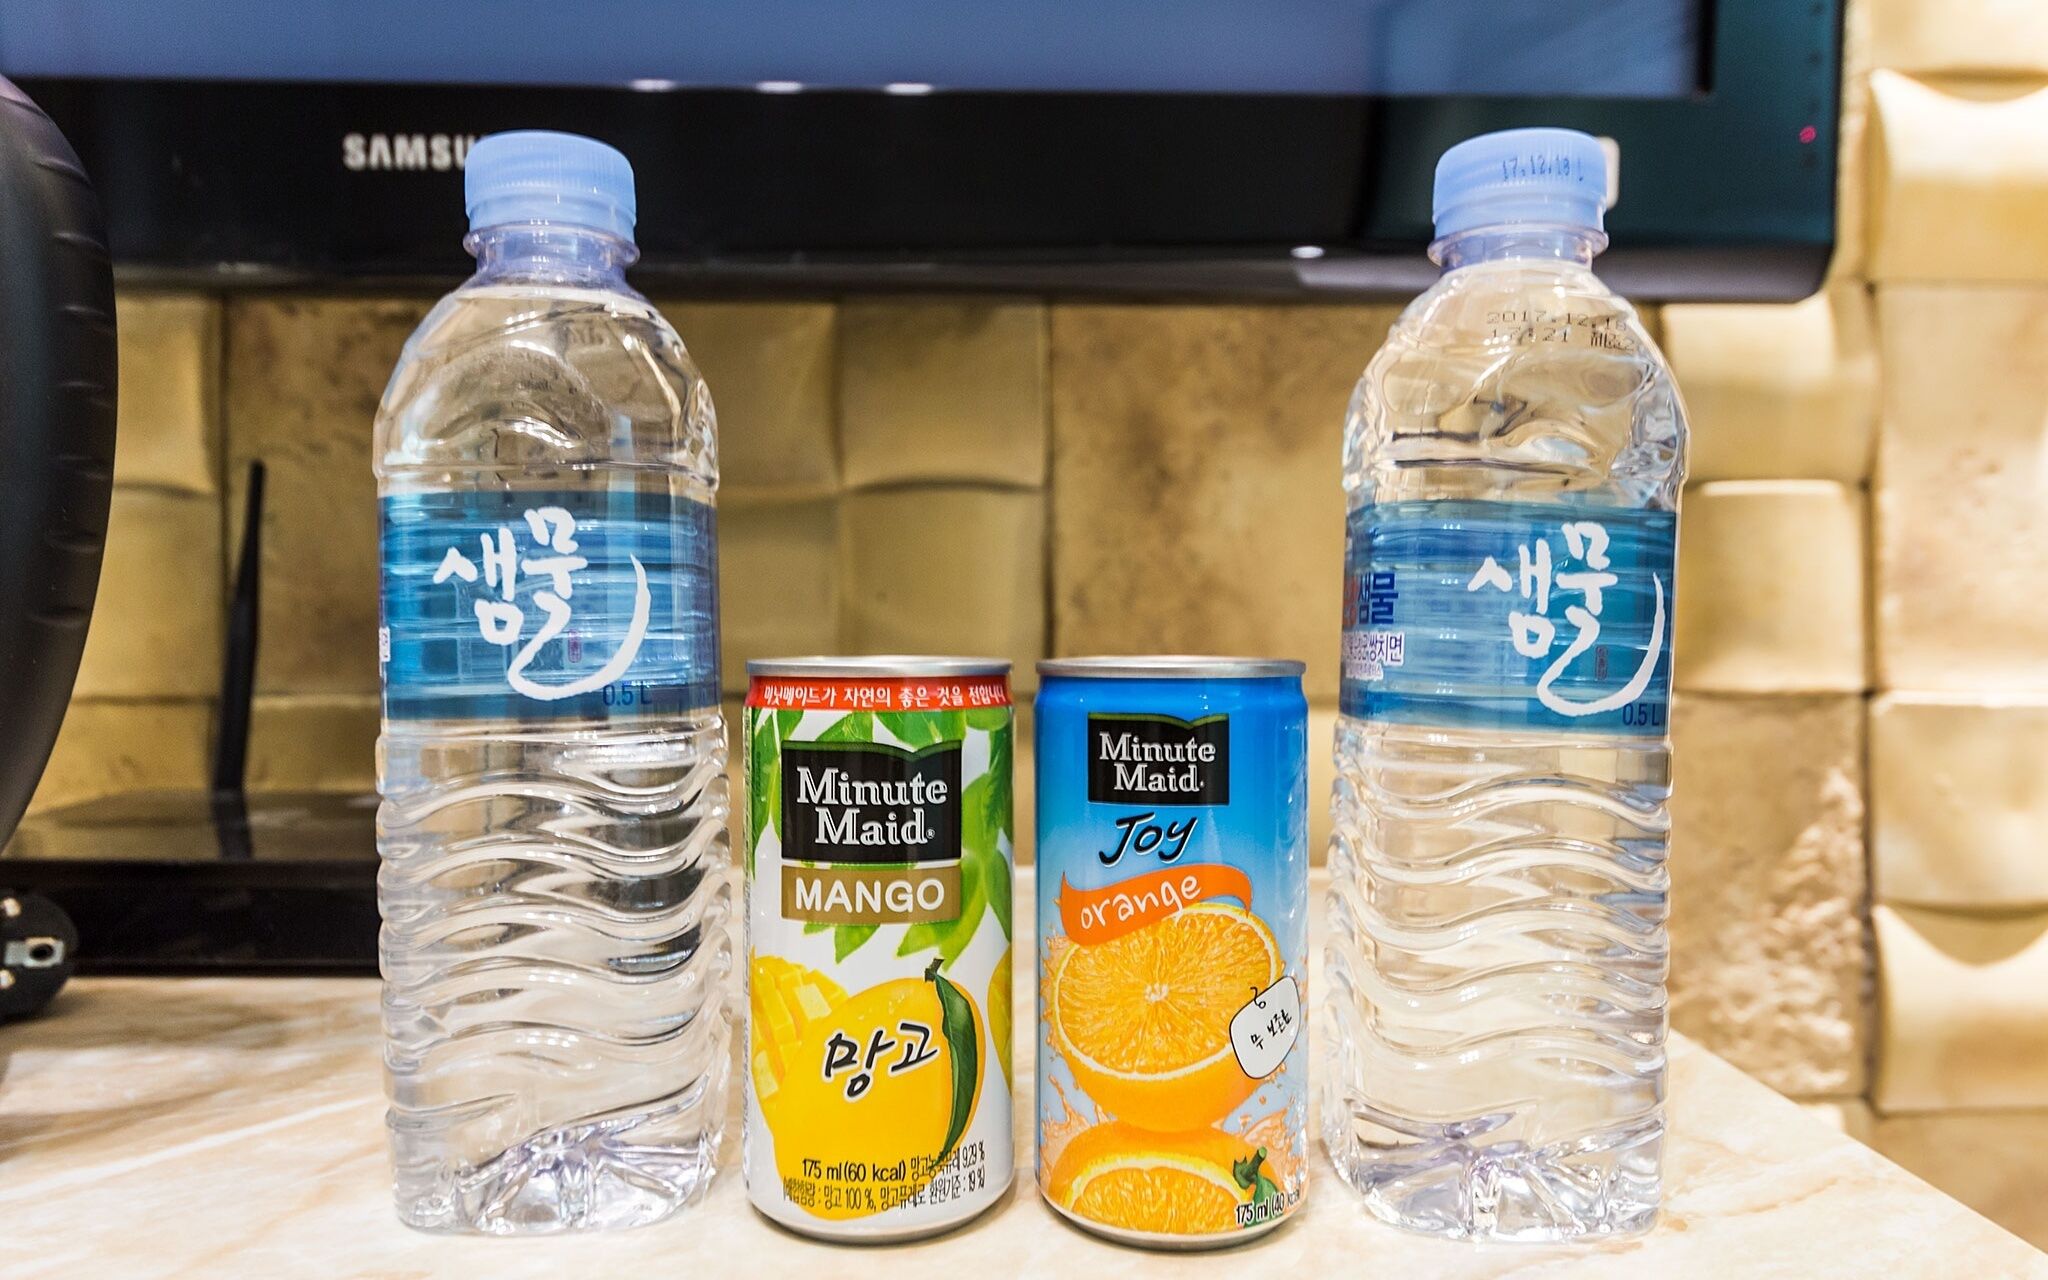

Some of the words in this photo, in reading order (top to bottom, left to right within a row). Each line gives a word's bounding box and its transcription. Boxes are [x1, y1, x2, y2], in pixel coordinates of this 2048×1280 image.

[343, 133, 477, 172] SAMSU
[603, 683, 634, 706] 0.5
[640, 681, 653, 705] L
[844, 686, 891, 708] 자연의
[899, 685, 930, 708] 좋은
[937, 685, 964, 707] 것을
[1622, 703, 1648, 726] 0.5
[1651, 703, 1660, 726] L
[1099, 731, 1216, 763] Minute
[797, 766, 948, 806] Minute
[795, 878, 945, 913] MANGO
[1080, 875, 1202, 929] orange
[824, 1021, 939, 1099] 망고
[802, 1158, 822, 1180] 175
[872, 1159, 906, 1183] kcal)
[824, 1185, 842, 1210] 망고
[845, 1187, 862, 1210] 100
[1236, 1202, 1254, 1225] 175
[1257, 1198, 1269, 1220] ml
